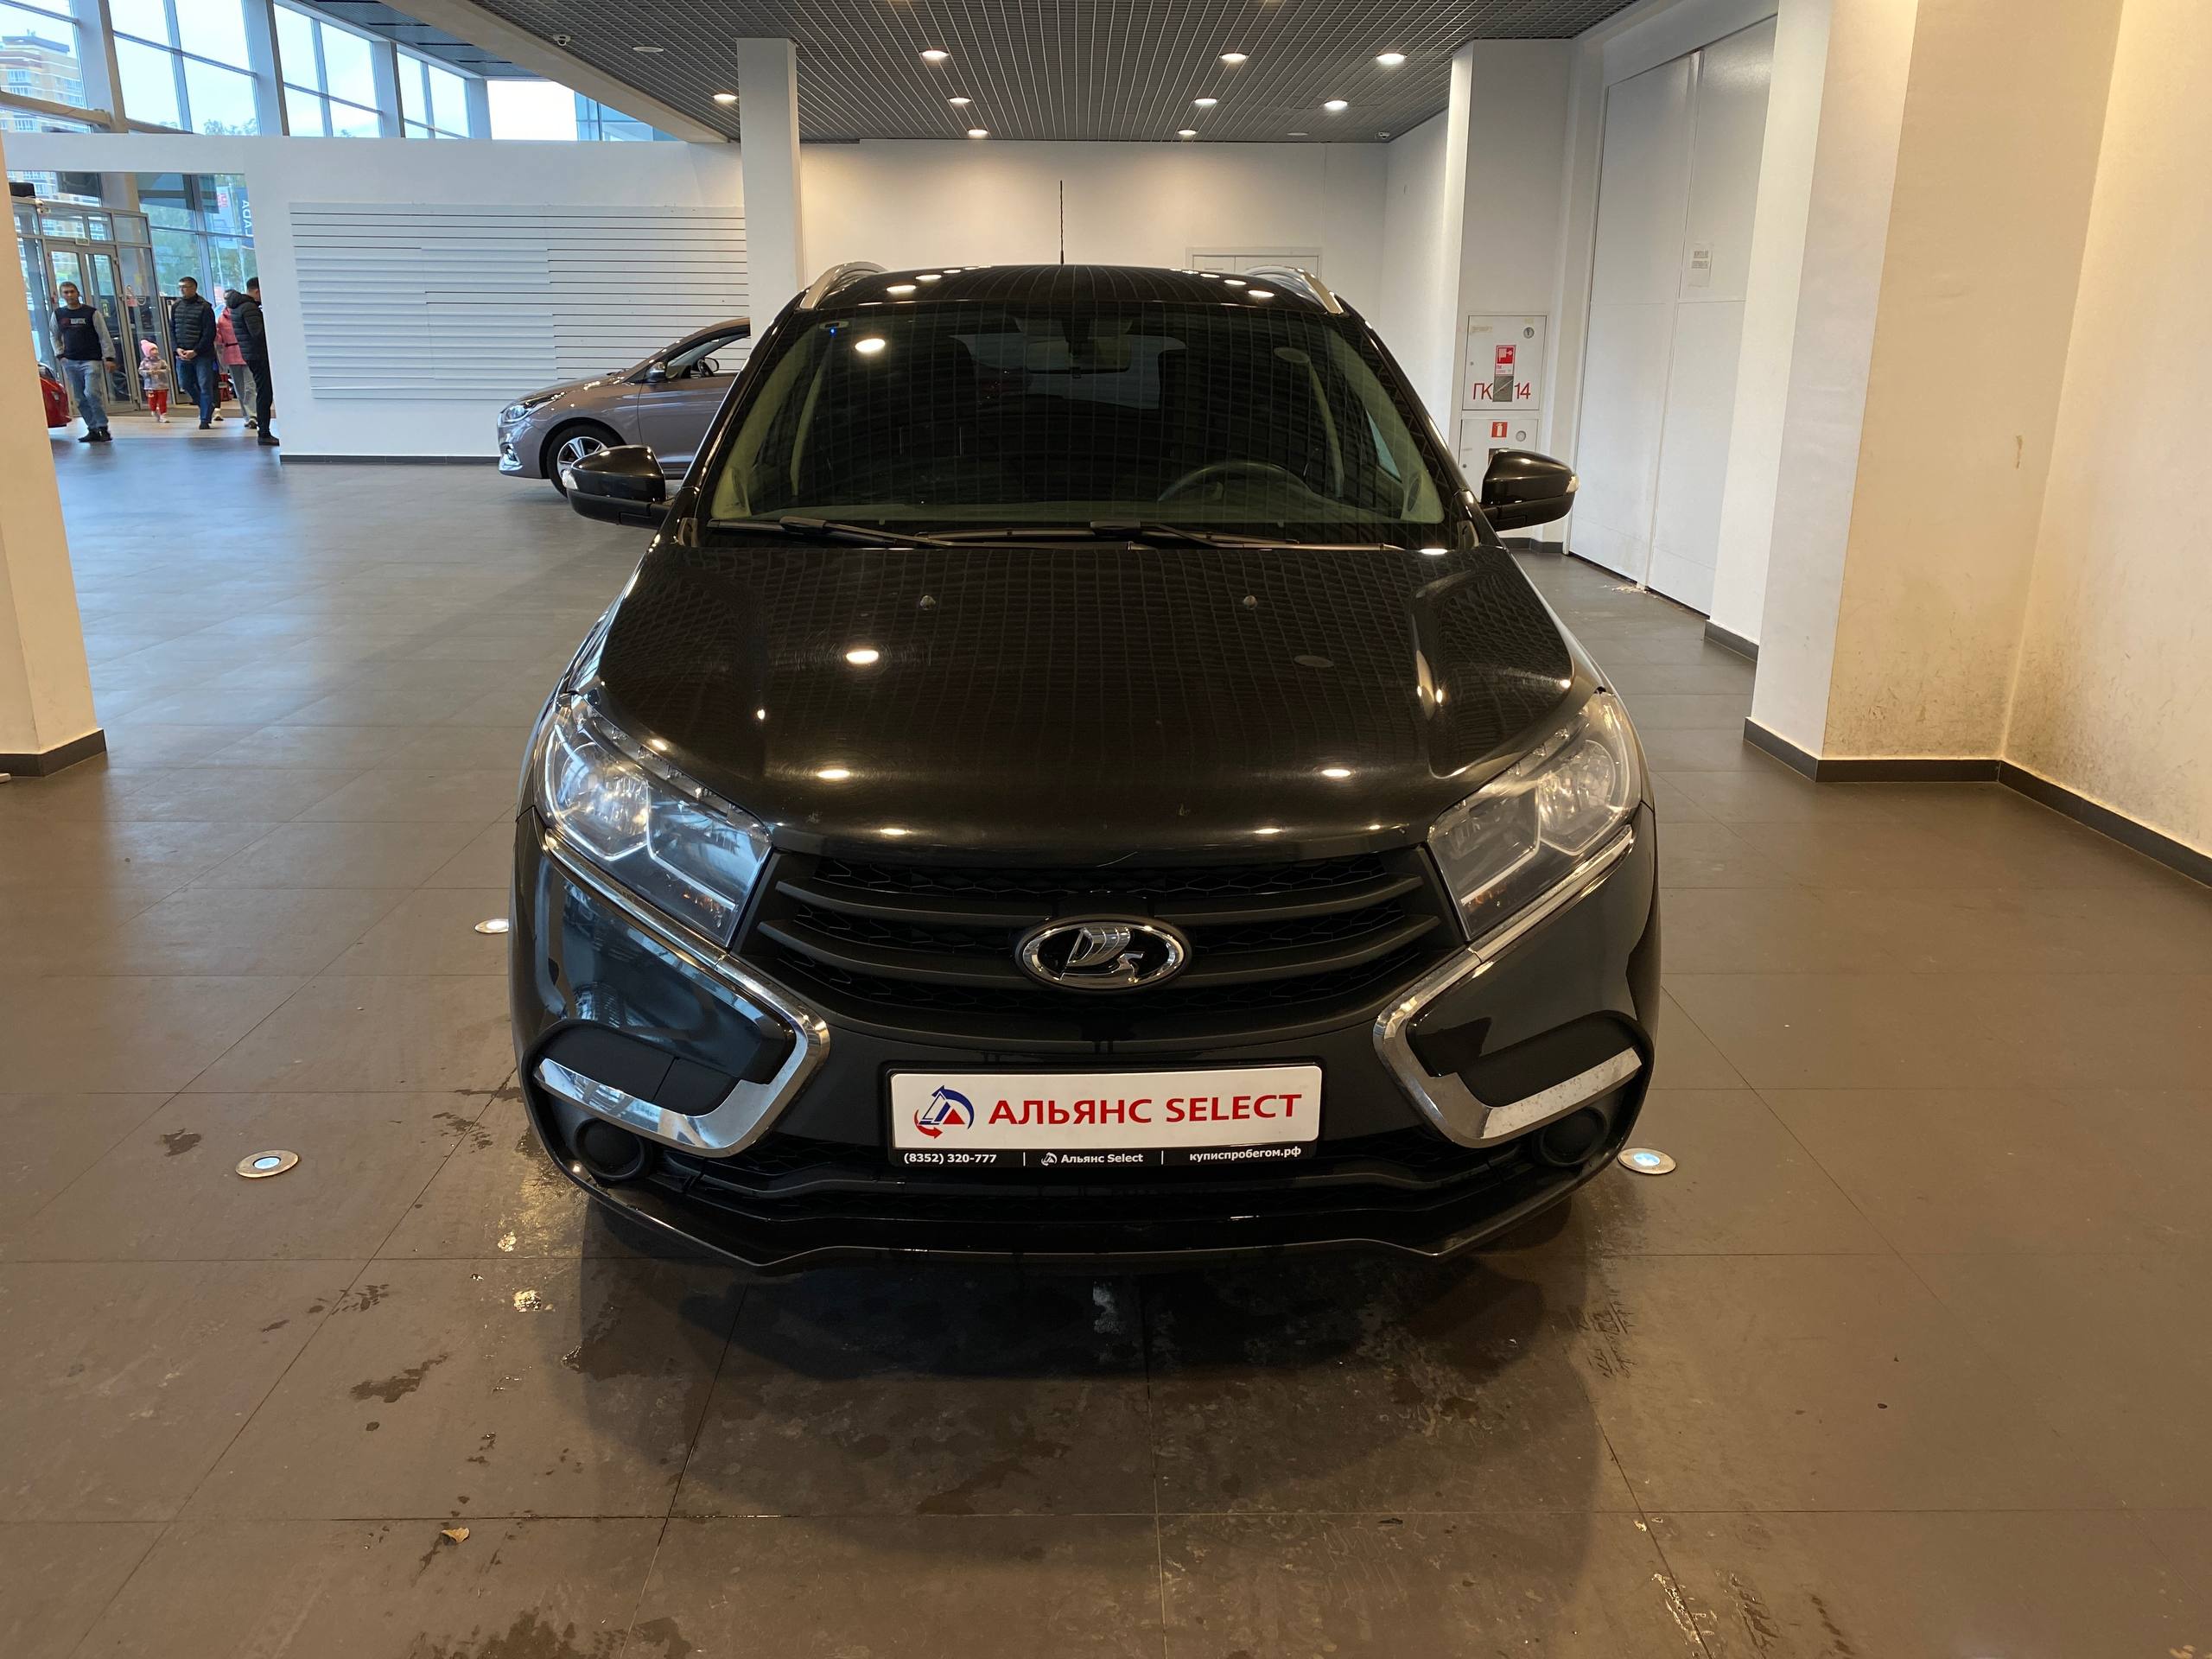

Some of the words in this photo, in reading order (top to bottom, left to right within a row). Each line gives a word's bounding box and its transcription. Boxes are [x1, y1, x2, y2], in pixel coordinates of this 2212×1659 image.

[1472, 383, 1493, 399] ПК
[1514, 382, 1530, 399] 14
[988, 1099, 1152, 1124] АЛЬЯНС
[1166, 1094, 1302, 1122] SELECT
[904, 1154, 944, 1165] (8352)
[947, 1154, 997, 1163] 320-777
[1061, 1154, 1104, 1164] Альянс
[1107, 1154, 1143, 1162] Select
[1189, 1147, 1301, 1162] куписпробегом.рф
